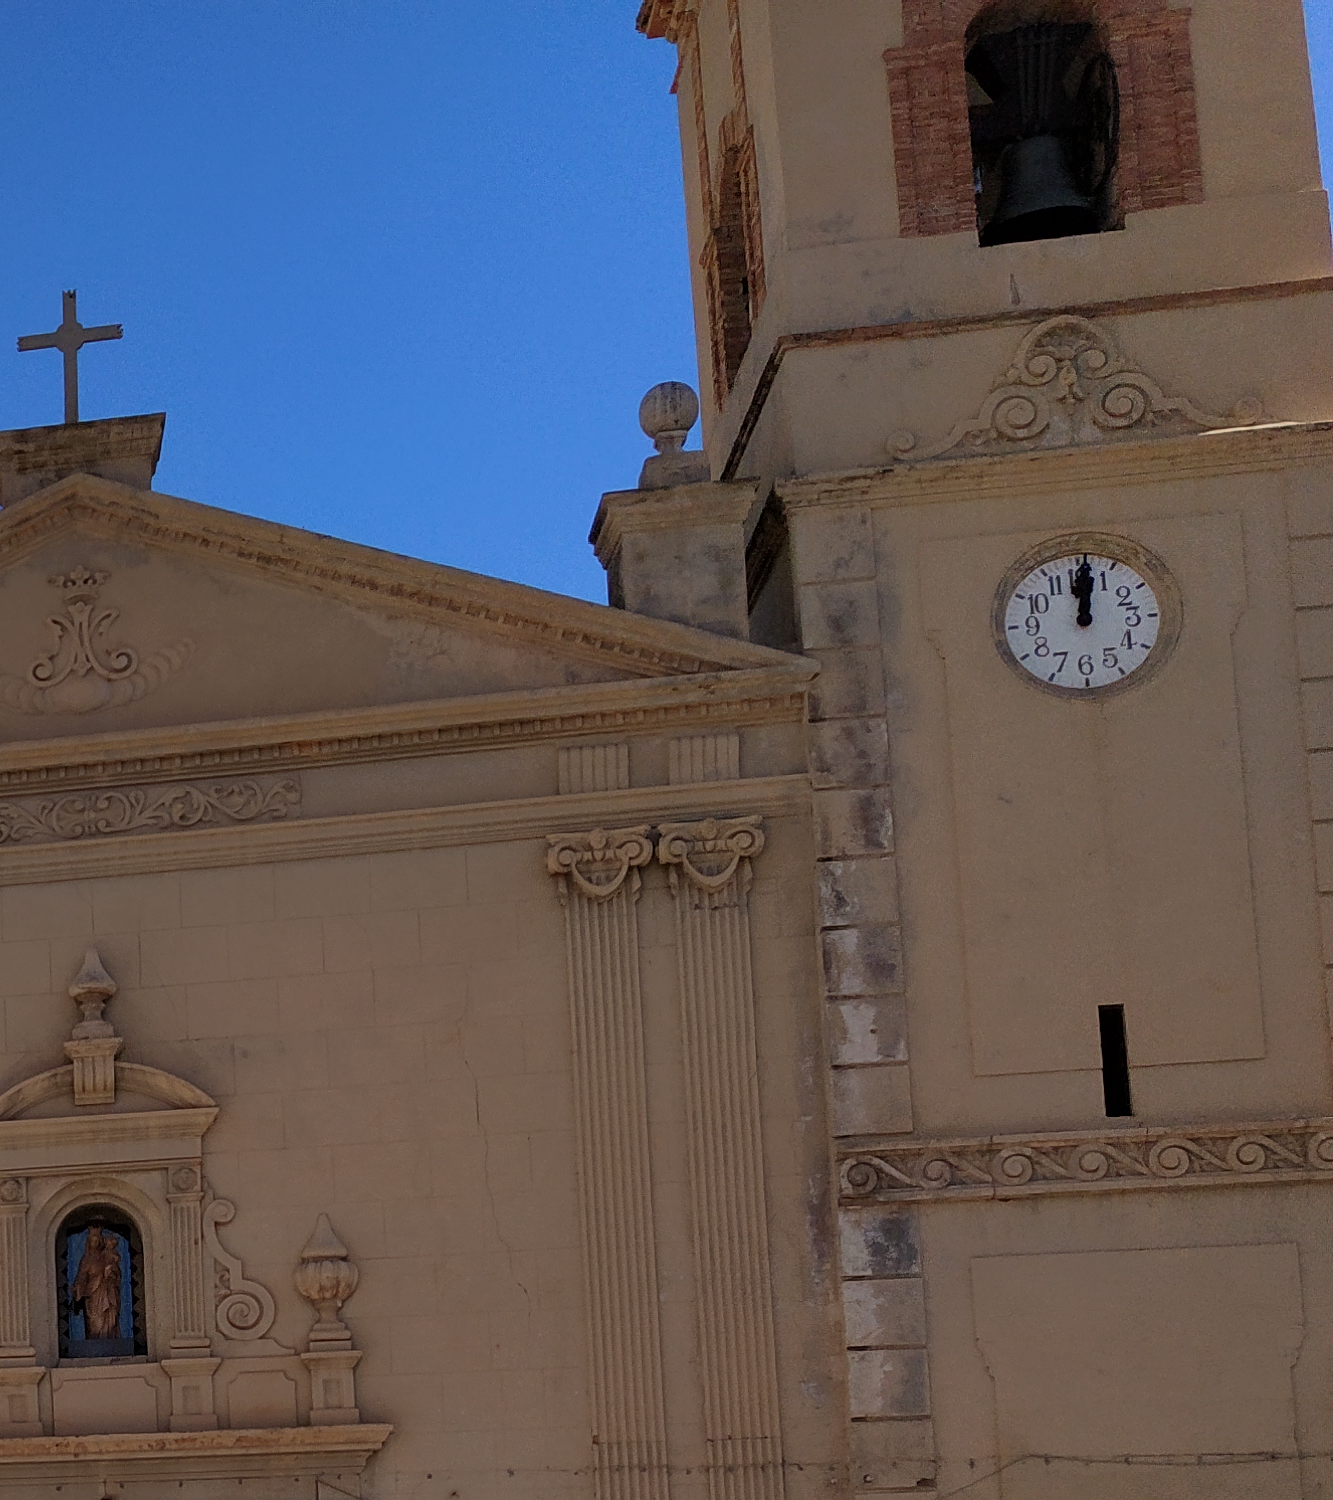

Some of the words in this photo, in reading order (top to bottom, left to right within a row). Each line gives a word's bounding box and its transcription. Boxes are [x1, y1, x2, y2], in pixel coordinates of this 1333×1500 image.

[1048, 575, 1063, 596] 11
[1100, 571, 1108, 591] 1
[1027, 593, 1049, 614] 10
[1115, 586, 1132, 607] 2
[1025, 616, 1040, 636] 9
[1125, 606, 1141, 627] 3
[1034, 637, 1050, 658] 8
[1120, 629, 1137, 650] 4
[1053, 651, 1068, 673] 7
[1078, 655, 1094, 676] 6
[1103, 647, 1118, 668] 5
